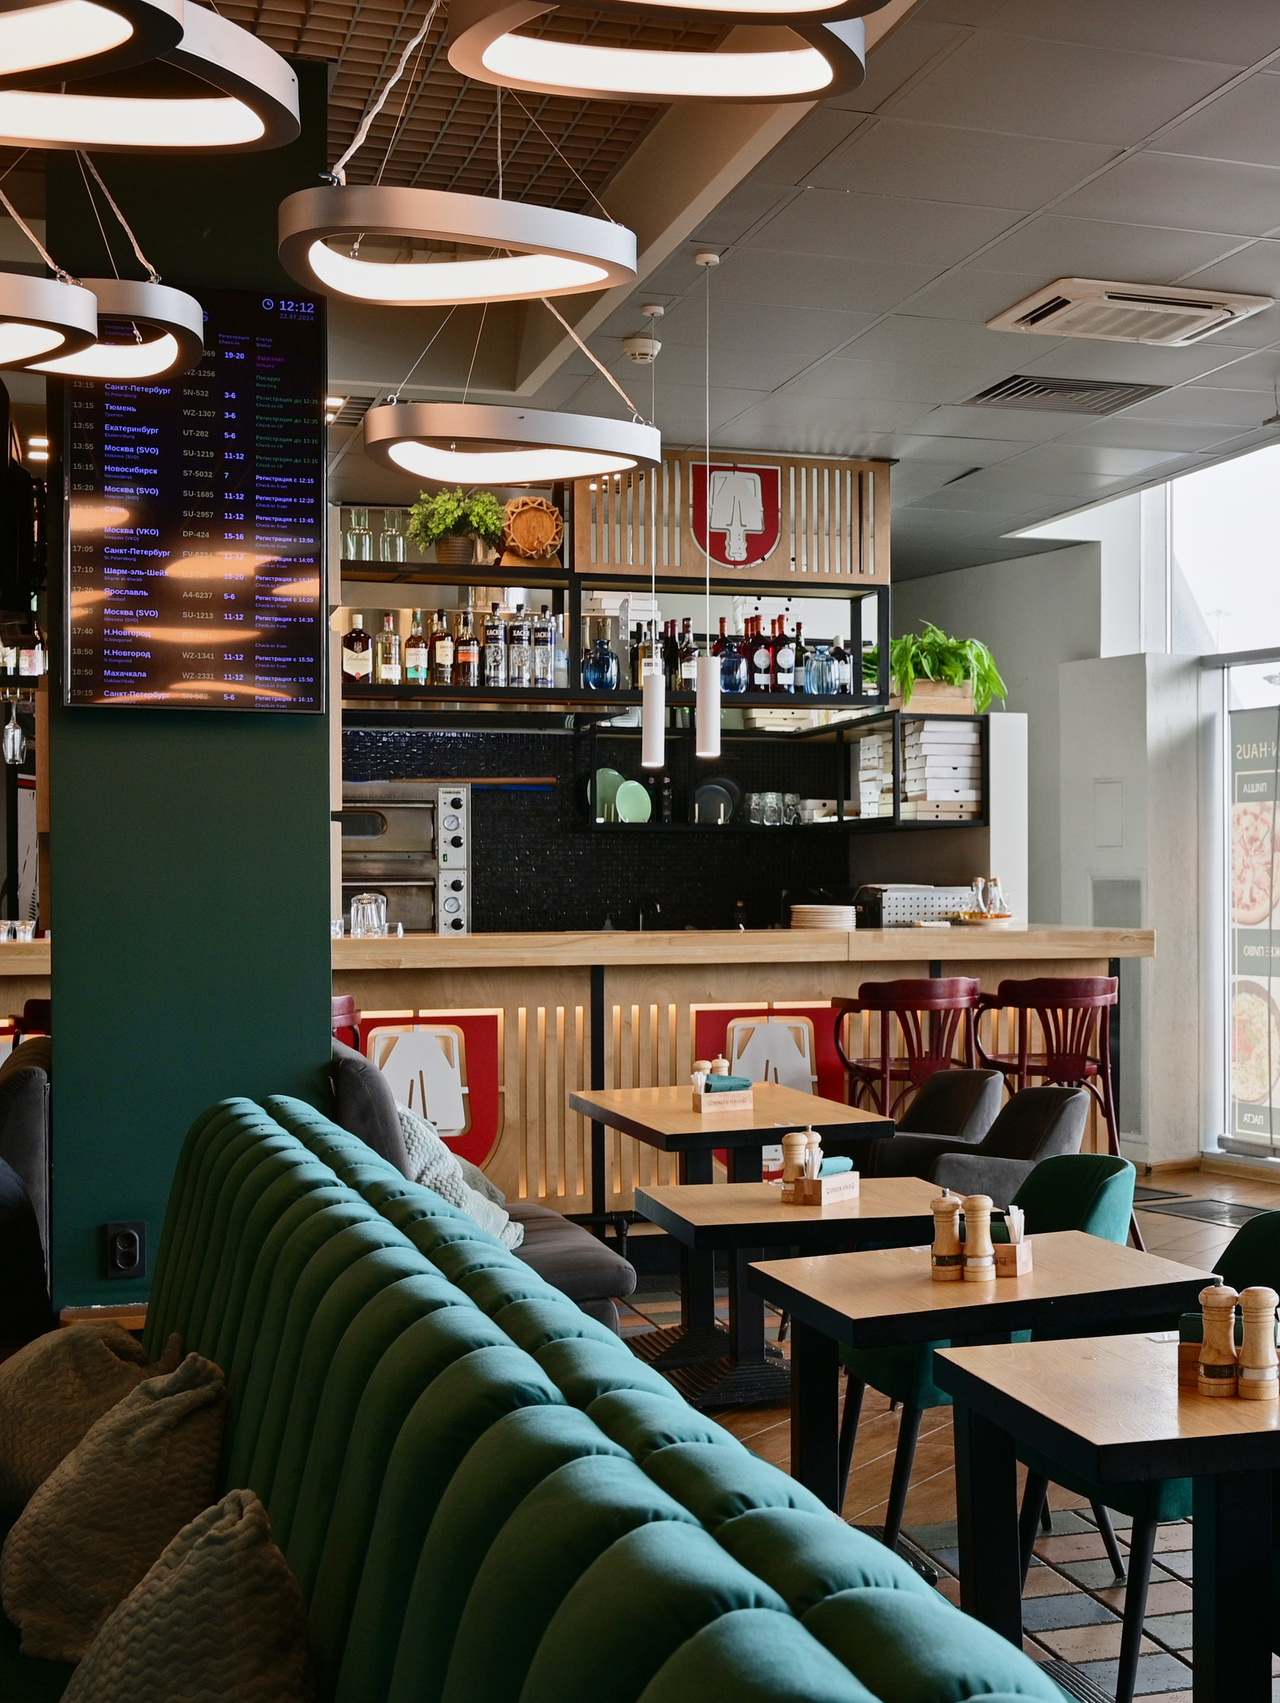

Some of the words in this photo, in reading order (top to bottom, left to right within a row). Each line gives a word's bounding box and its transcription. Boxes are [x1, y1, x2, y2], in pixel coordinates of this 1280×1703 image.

[280, 301, 314, 313] 12:12
[256, 375, 281, 383] Посадка
[73, 381, 94, 389] 13:15
[104, 383, 171, 395] Санкт-Петербург
[183, 389, 209, 397] 5N-532
[73, 401, 94, 409] 13:15
[104, 403, 137, 412] Тюмень
[183, 409, 216, 418] WZ-1307
[73, 422, 94, 430] 13:55
[104, 424, 159, 435] Екатеринбург
[183, 429, 209, 438] UT-282
[73, 442, 94, 450] 13:55
[104, 444, 134, 452] Москва
[136, 446, 159, 455] (SVO)
[183, 449, 214, 458] SU-1219
[224, 452, 244, 460] 11-12
[73, 463, 94, 471] 15:15
[104, 465, 158, 475] Новосибирск
[183, 470, 213, 478] S7-5032
[73, 483, 94, 491] 15:20
[104, 485, 134, 493] Москва
[136, 487, 159, 496] (SVO)
[183, 490, 214, 498] SU-1685
[224, 492, 244, 500] 11-12
[104, 505, 125, 513] Сочи
[183, 510, 214, 518] SU-2957
[104, 526, 134, 534] Москва
[136, 528, 159, 537] (VKO)
[183, 530, 210, 538] DP-424
[73, 545, 93, 553] 17:05
[104, 547, 171, 557] Санкт-Петербург
[104, 567, 169, 577] Шарм-эль-Шейх
[104, 587, 149, 596] Ярославль
[182, 591, 213, 599] A4-6237
[104, 608, 134, 616] Москва
[136, 609, 159, 618] (SVO)
[182, 611, 214, 619] SU-1213
[104, 628, 151, 638] Н.Новгород
[104, 649, 151, 659] Н.Новгород
[182, 652, 215, 660] WZ-1341
[182, 672, 214, 680] WZ-2331
[104, 690, 170, 699] Санкт-Петербург
